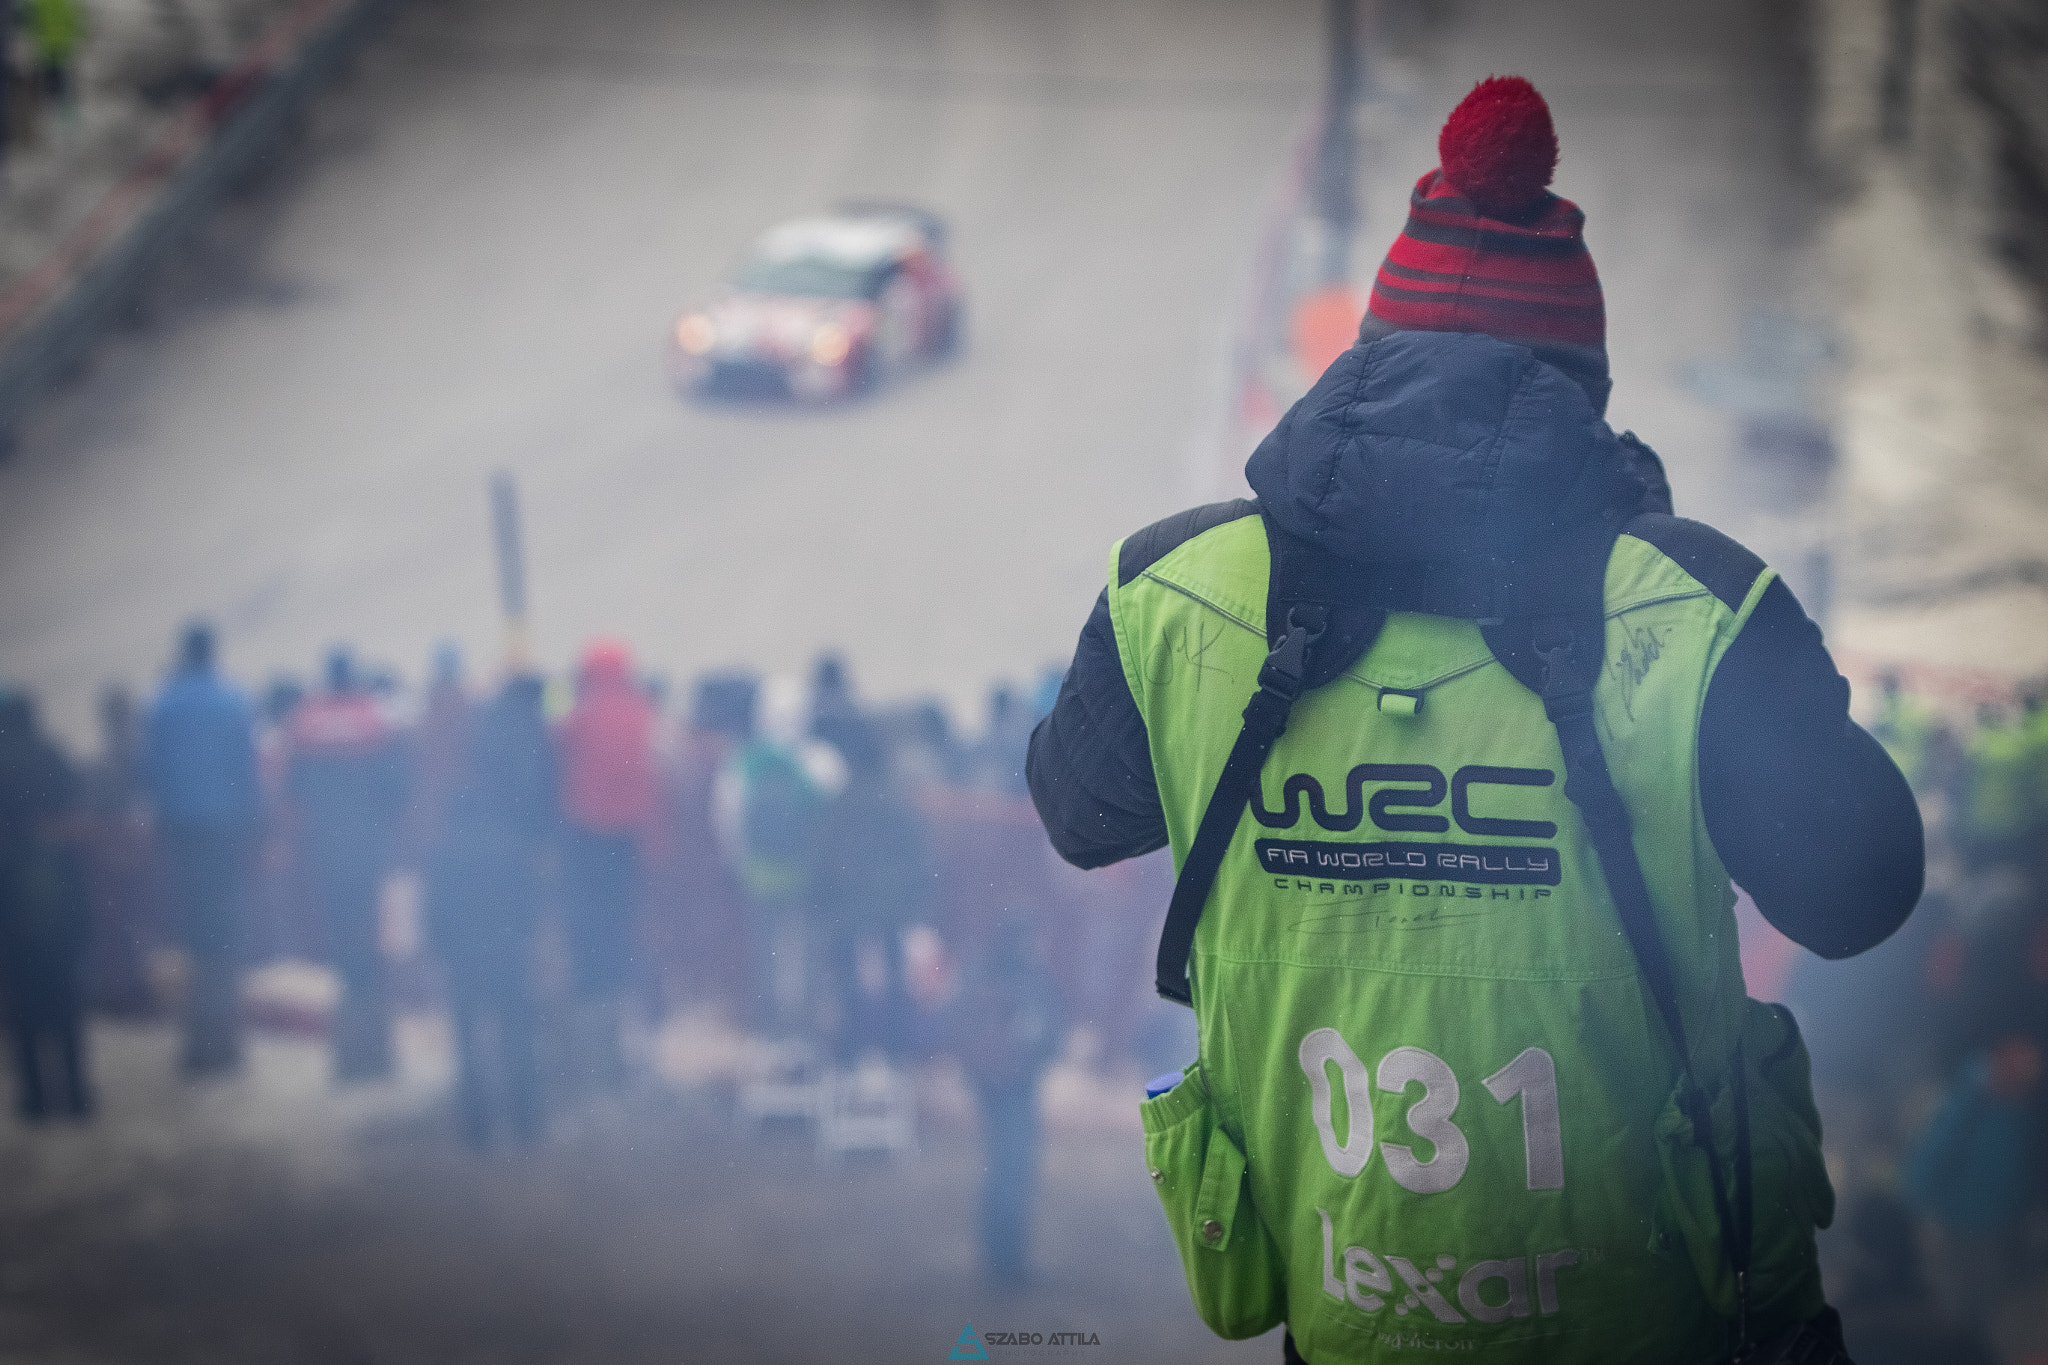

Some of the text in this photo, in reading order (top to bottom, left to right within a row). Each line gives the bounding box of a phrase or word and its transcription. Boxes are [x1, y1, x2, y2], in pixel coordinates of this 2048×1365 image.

[1249, 762, 1559, 839] WRC
[1267, 848, 1550, 871] FIA WORLD RALLY
[1274, 877, 1552, 901] CHAMPIONSHIP
[1298, 1027, 1565, 1194] 031
[1315, 1206, 1581, 1324] Lexar
